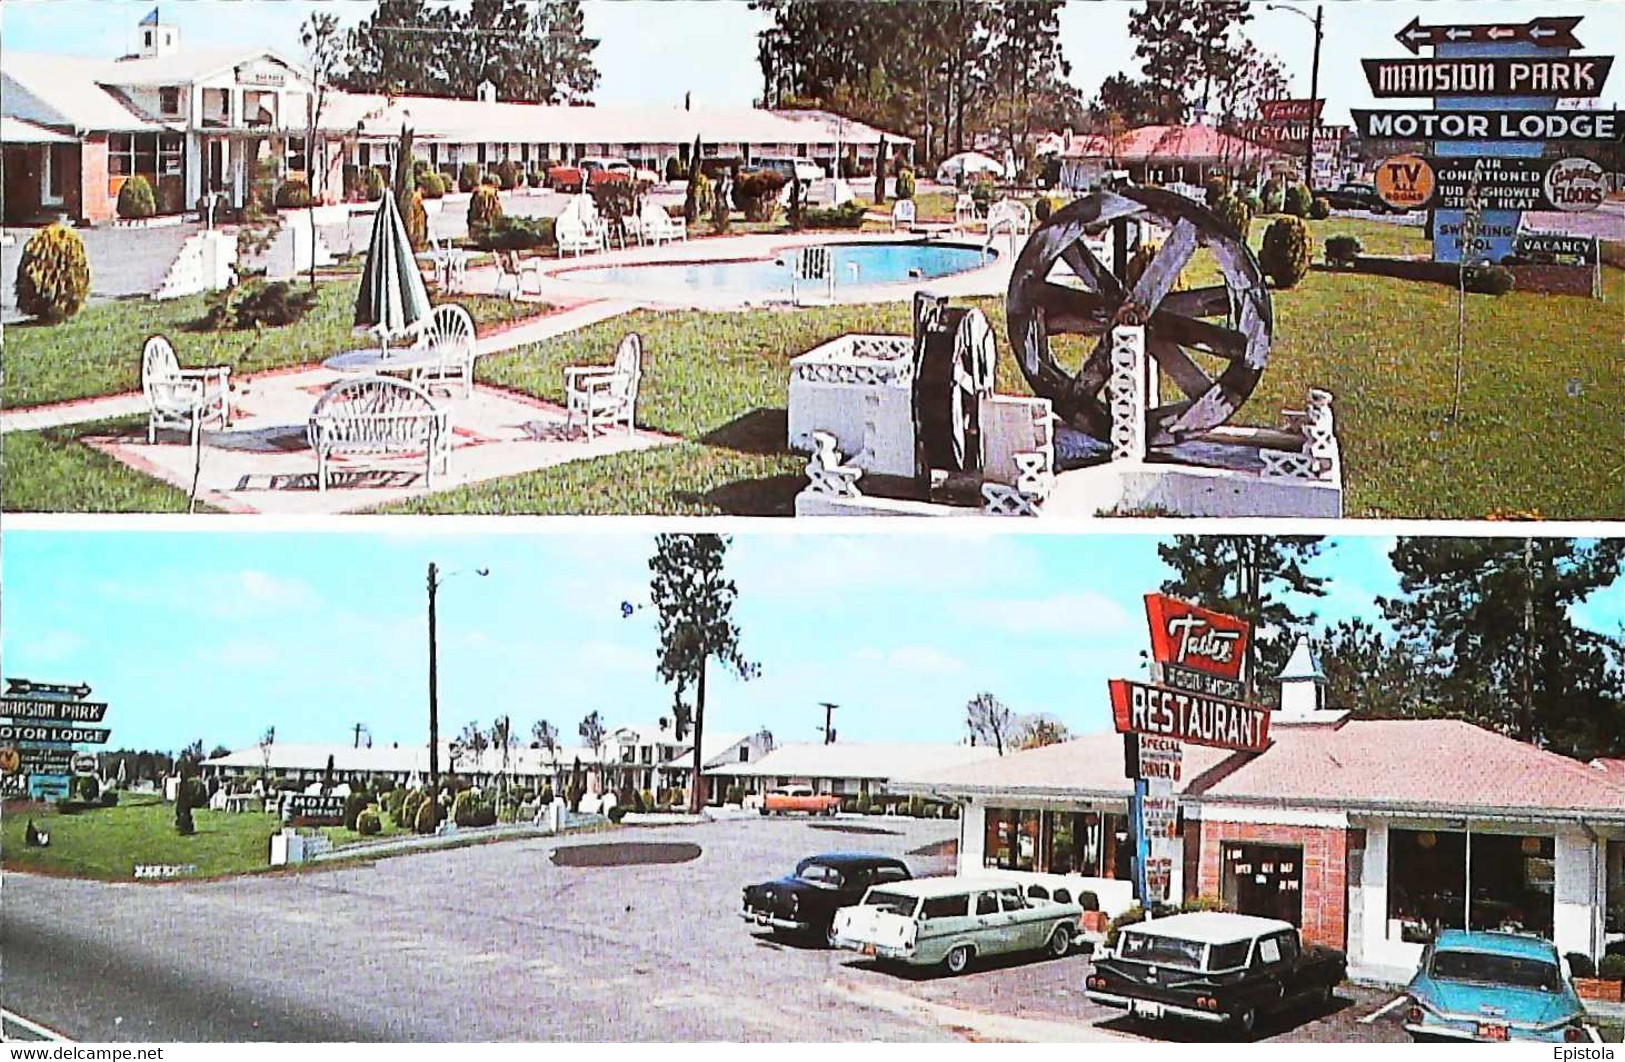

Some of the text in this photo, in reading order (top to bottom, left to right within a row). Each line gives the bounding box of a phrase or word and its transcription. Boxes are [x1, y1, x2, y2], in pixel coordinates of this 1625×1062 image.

[1379, 63, 1596, 92] MANSION PARK
[1369, 114, 1616, 138] MOTOR LODGE
[1475, 159, 1502, 169] AIR
[1387, 164, 1422, 182] TV
[1498, 198, 1536, 209] HEAT
[1553, 186, 1602, 204] FLOORS
[1439, 224, 1514, 237] SWIMING
[1523, 240, 1591, 253] VACANCY
[61, 703, 100, 719] PARK
[1131, 686, 1265, 747] RESTAURANT
[0, 727, 104, 741] OTOR LODGE
[1141, 735, 1181, 753] SPECIAL
